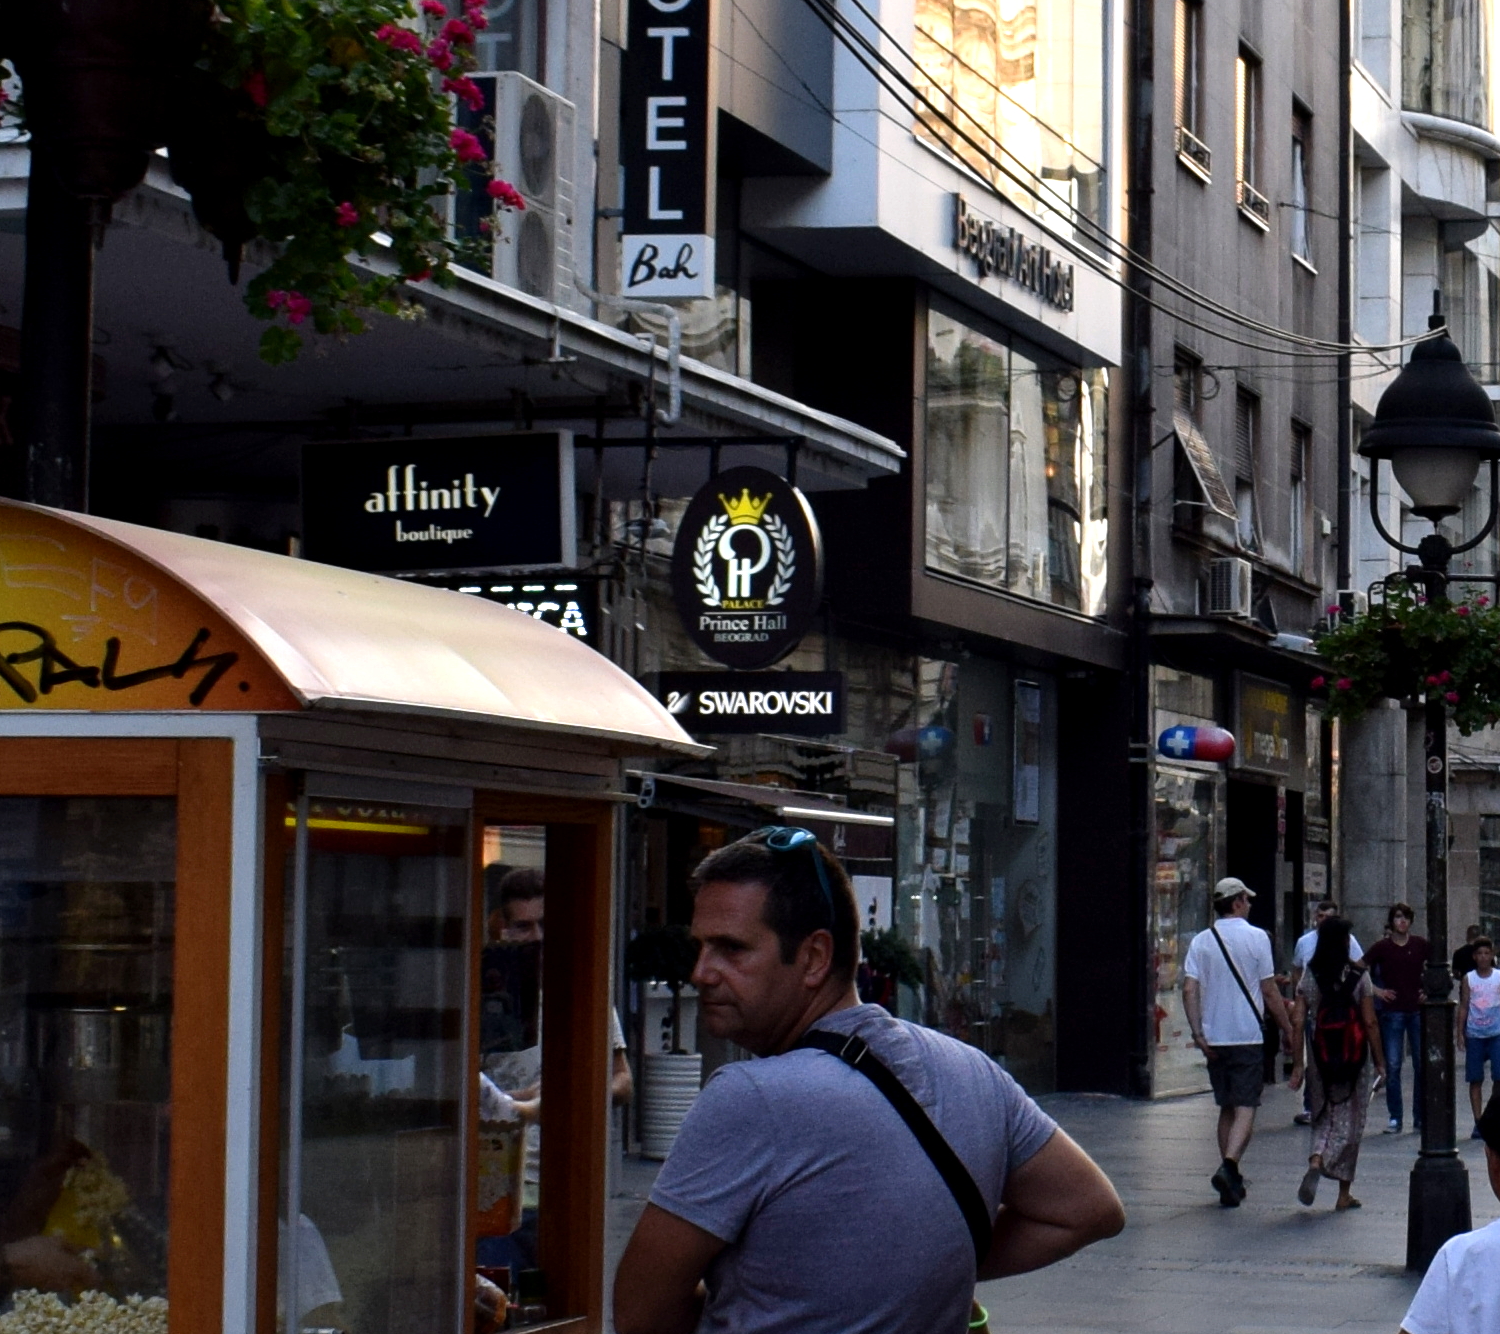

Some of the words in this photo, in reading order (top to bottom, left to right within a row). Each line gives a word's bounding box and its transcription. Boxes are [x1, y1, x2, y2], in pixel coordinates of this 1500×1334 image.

[363, 464, 501, 518] affinity
[395, 520, 474, 544] boutique
[721, 599, 765, 610] PALACE
[699, 615, 750, 631] Prince
[753, 614, 788, 630] Hall
[713, 631, 770, 643] BEOGRAD
[699, 690, 833, 716] SWAROVSKI
